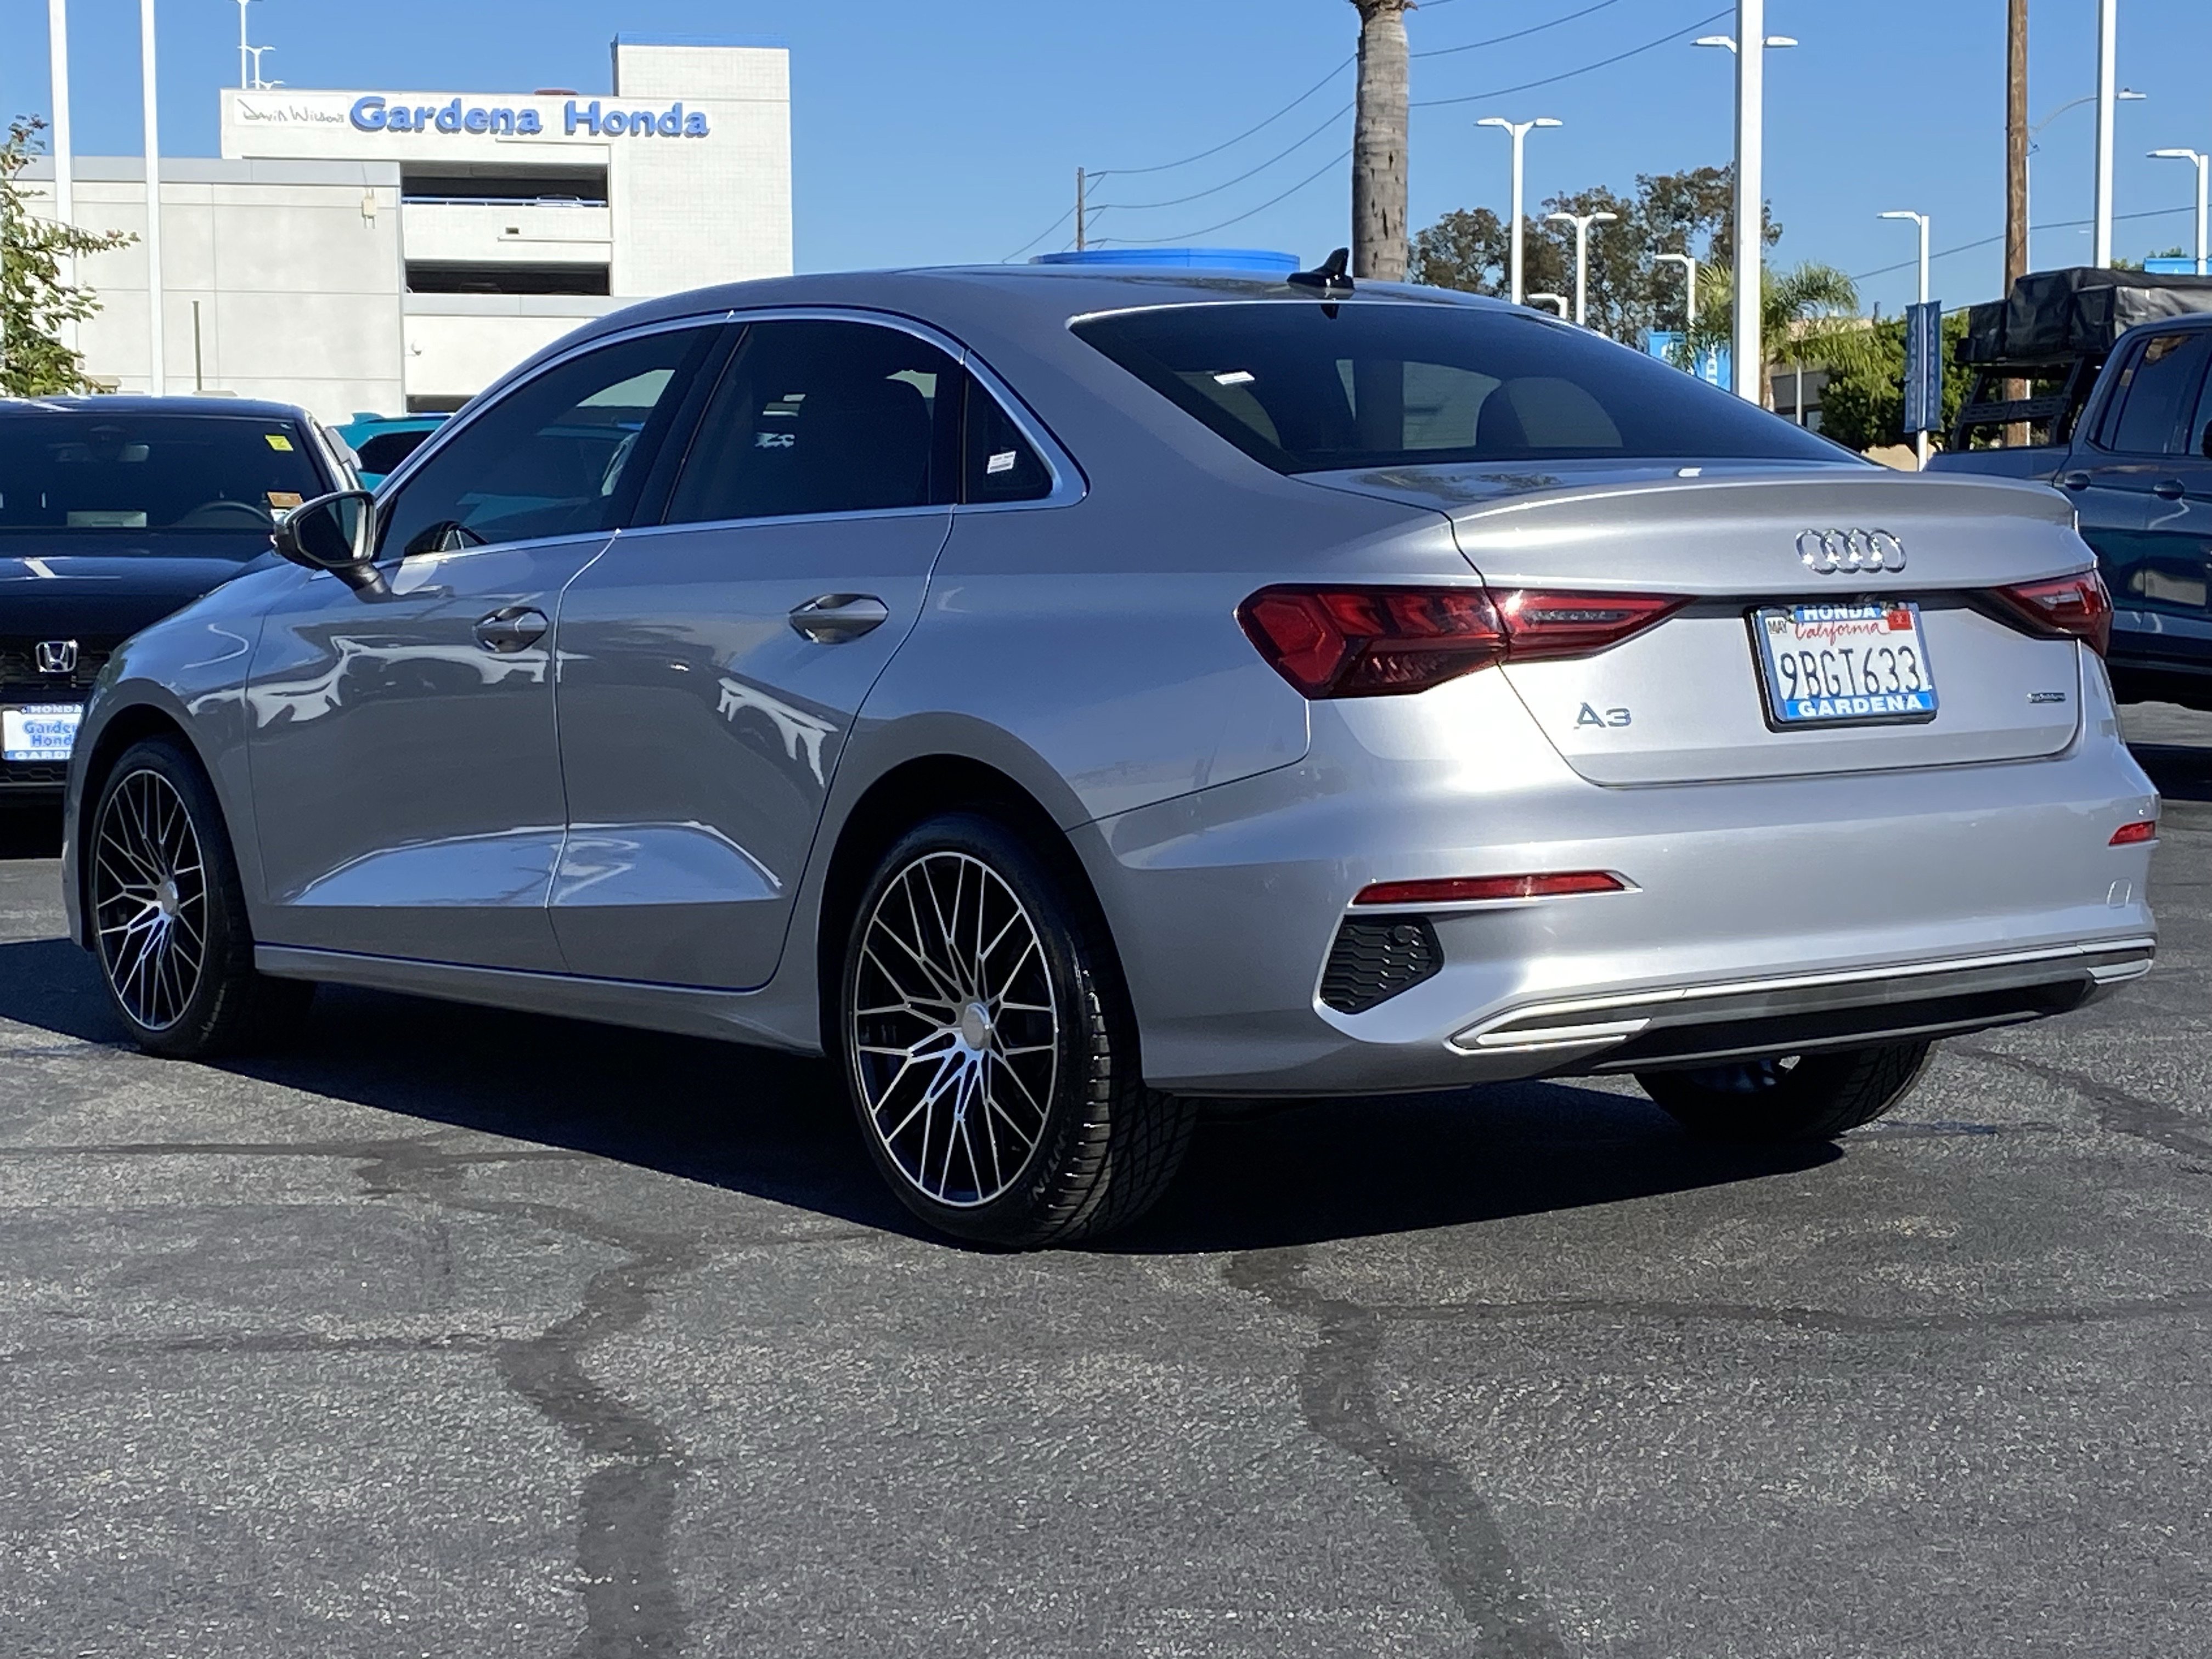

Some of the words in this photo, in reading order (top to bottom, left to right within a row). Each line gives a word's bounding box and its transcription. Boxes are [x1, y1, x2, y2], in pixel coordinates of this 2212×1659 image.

[349, 95, 544, 136] Gardena
[564, 100, 710, 138] Honda
[1802, 604, 1877, 620] HONDA
[1795, 619, 1892, 646] California
[1780, 645, 1922, 700] 9BGT633
[30, 704, 83, 714] HONDA
[1573, 702, 1632, 730] A3
[1797, 694, 1923, 717] GARDENA
[31, 733, 72, 747] Hond
